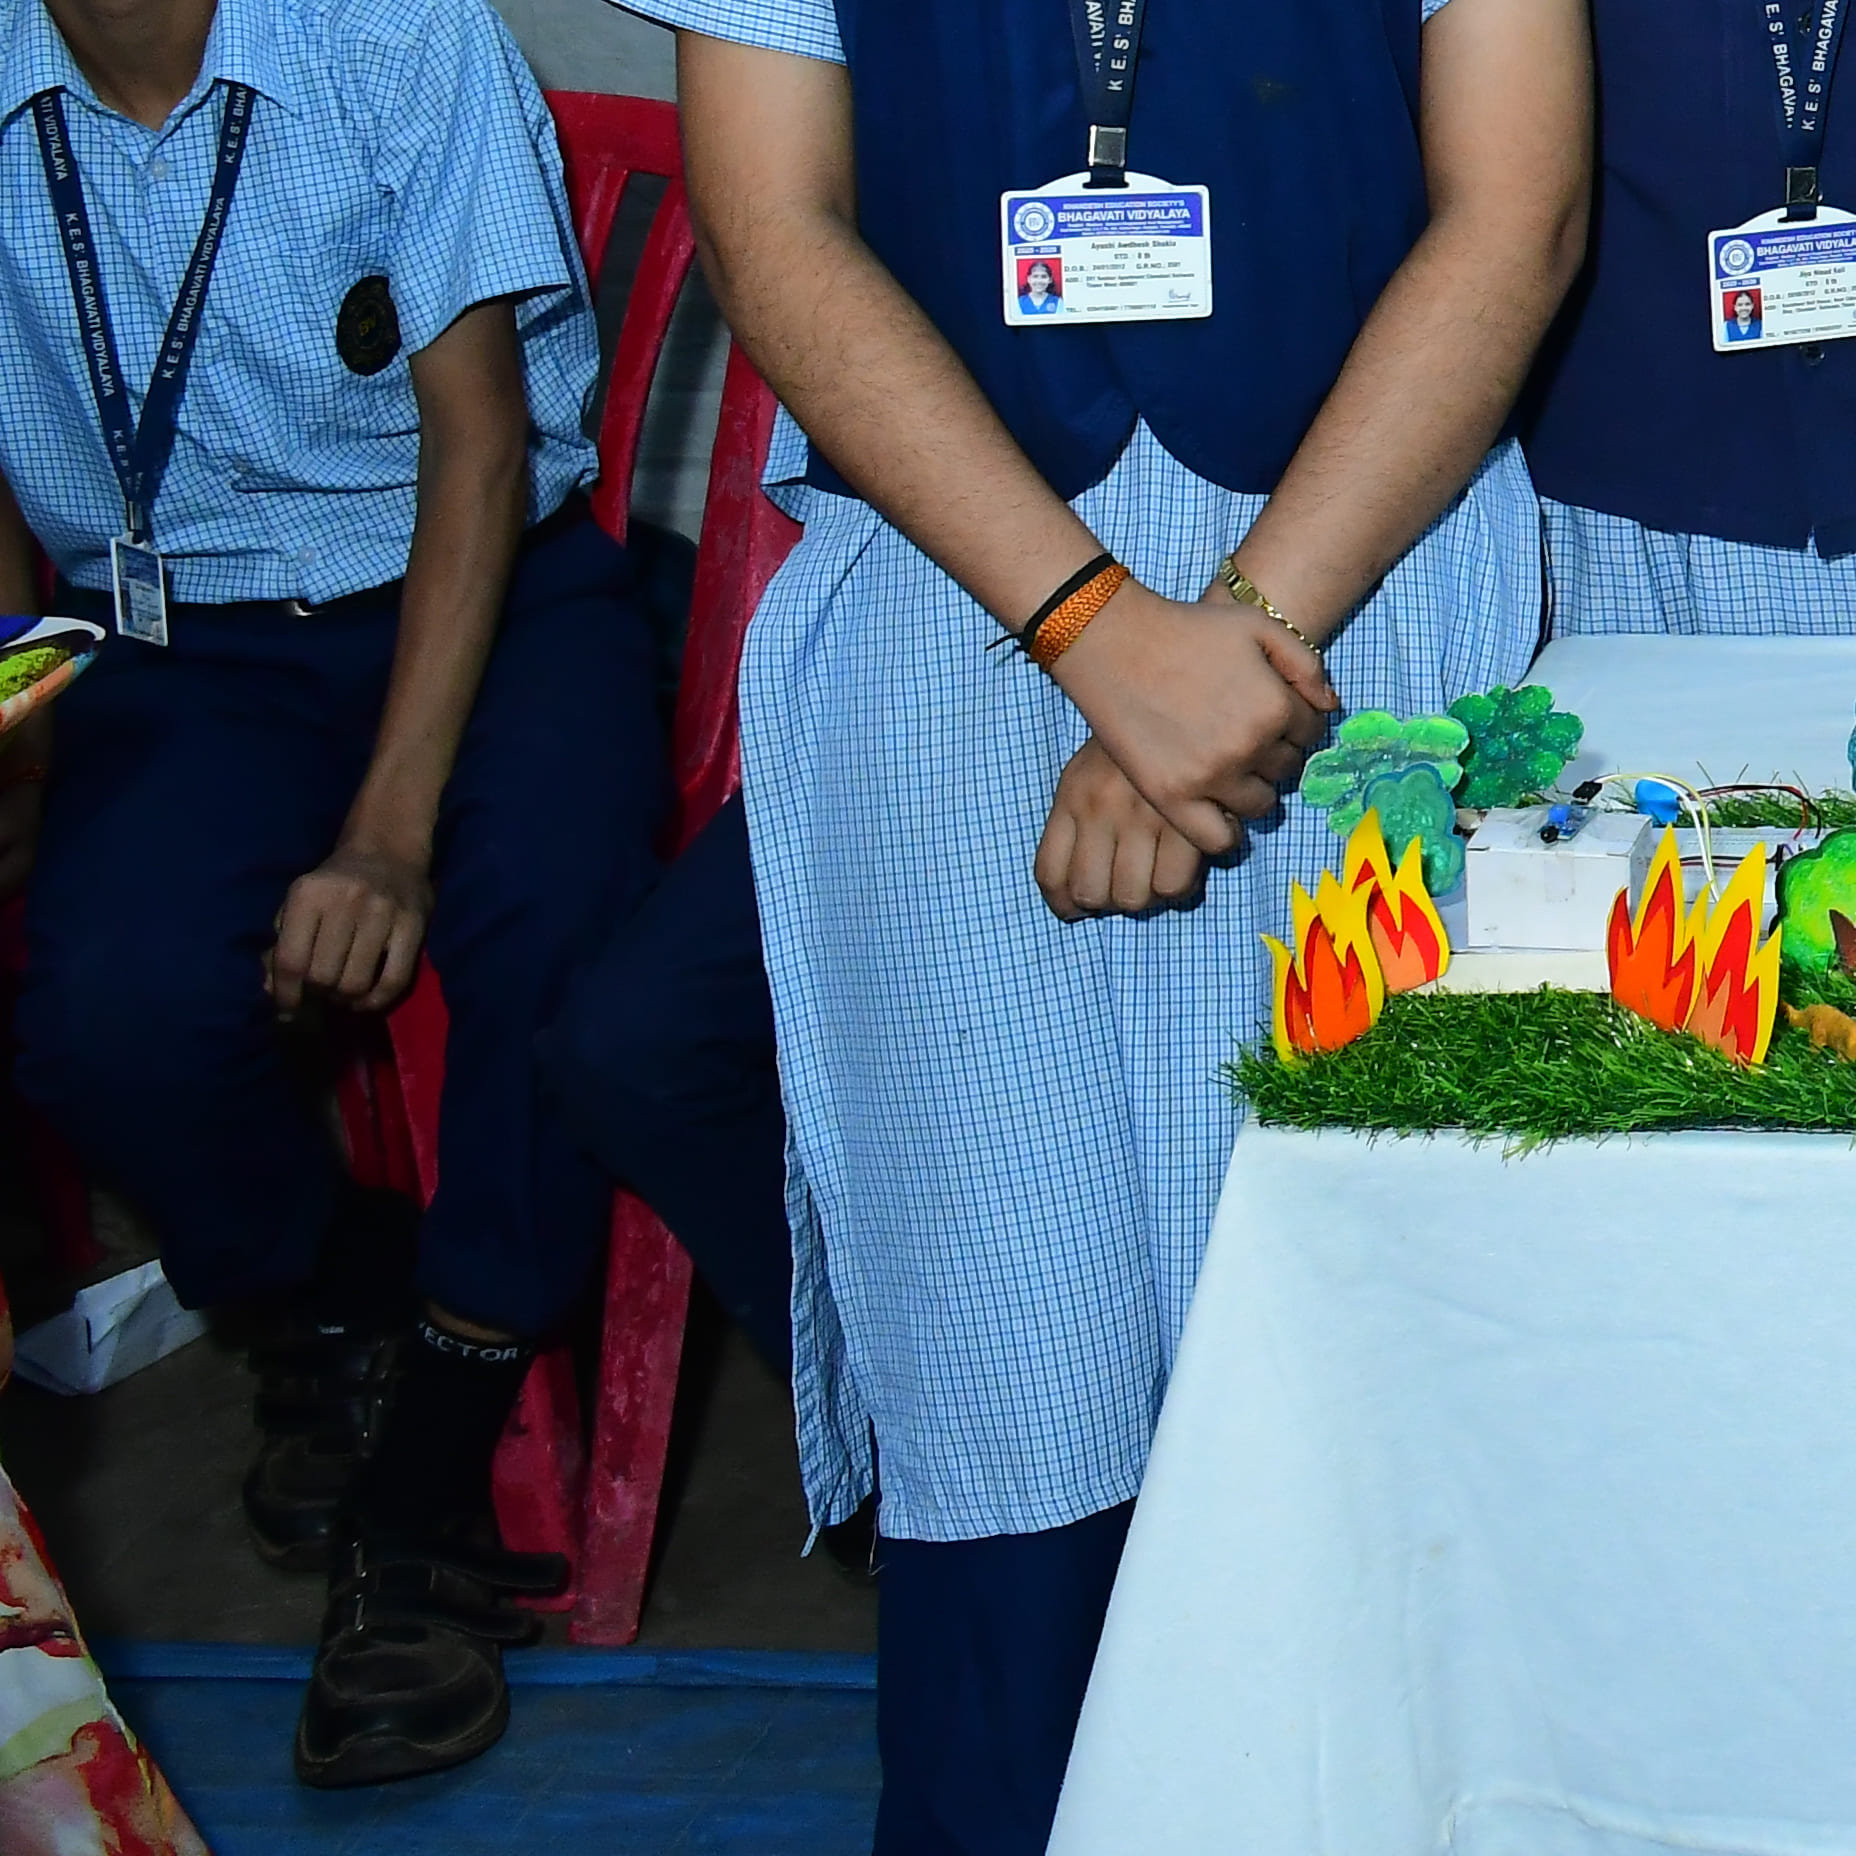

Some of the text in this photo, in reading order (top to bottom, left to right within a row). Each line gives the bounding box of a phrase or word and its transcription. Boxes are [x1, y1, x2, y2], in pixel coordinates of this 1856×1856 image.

[1058, 209, 1191, 222] BHAGAVATI VIDYALAYA
[1757, 243, 1814, 257] BHAGAVATI
[76, 260, 114, 397] BHAGAVATI VIDYALAYA
[418, 1321, 518, 1361] ECTOR
